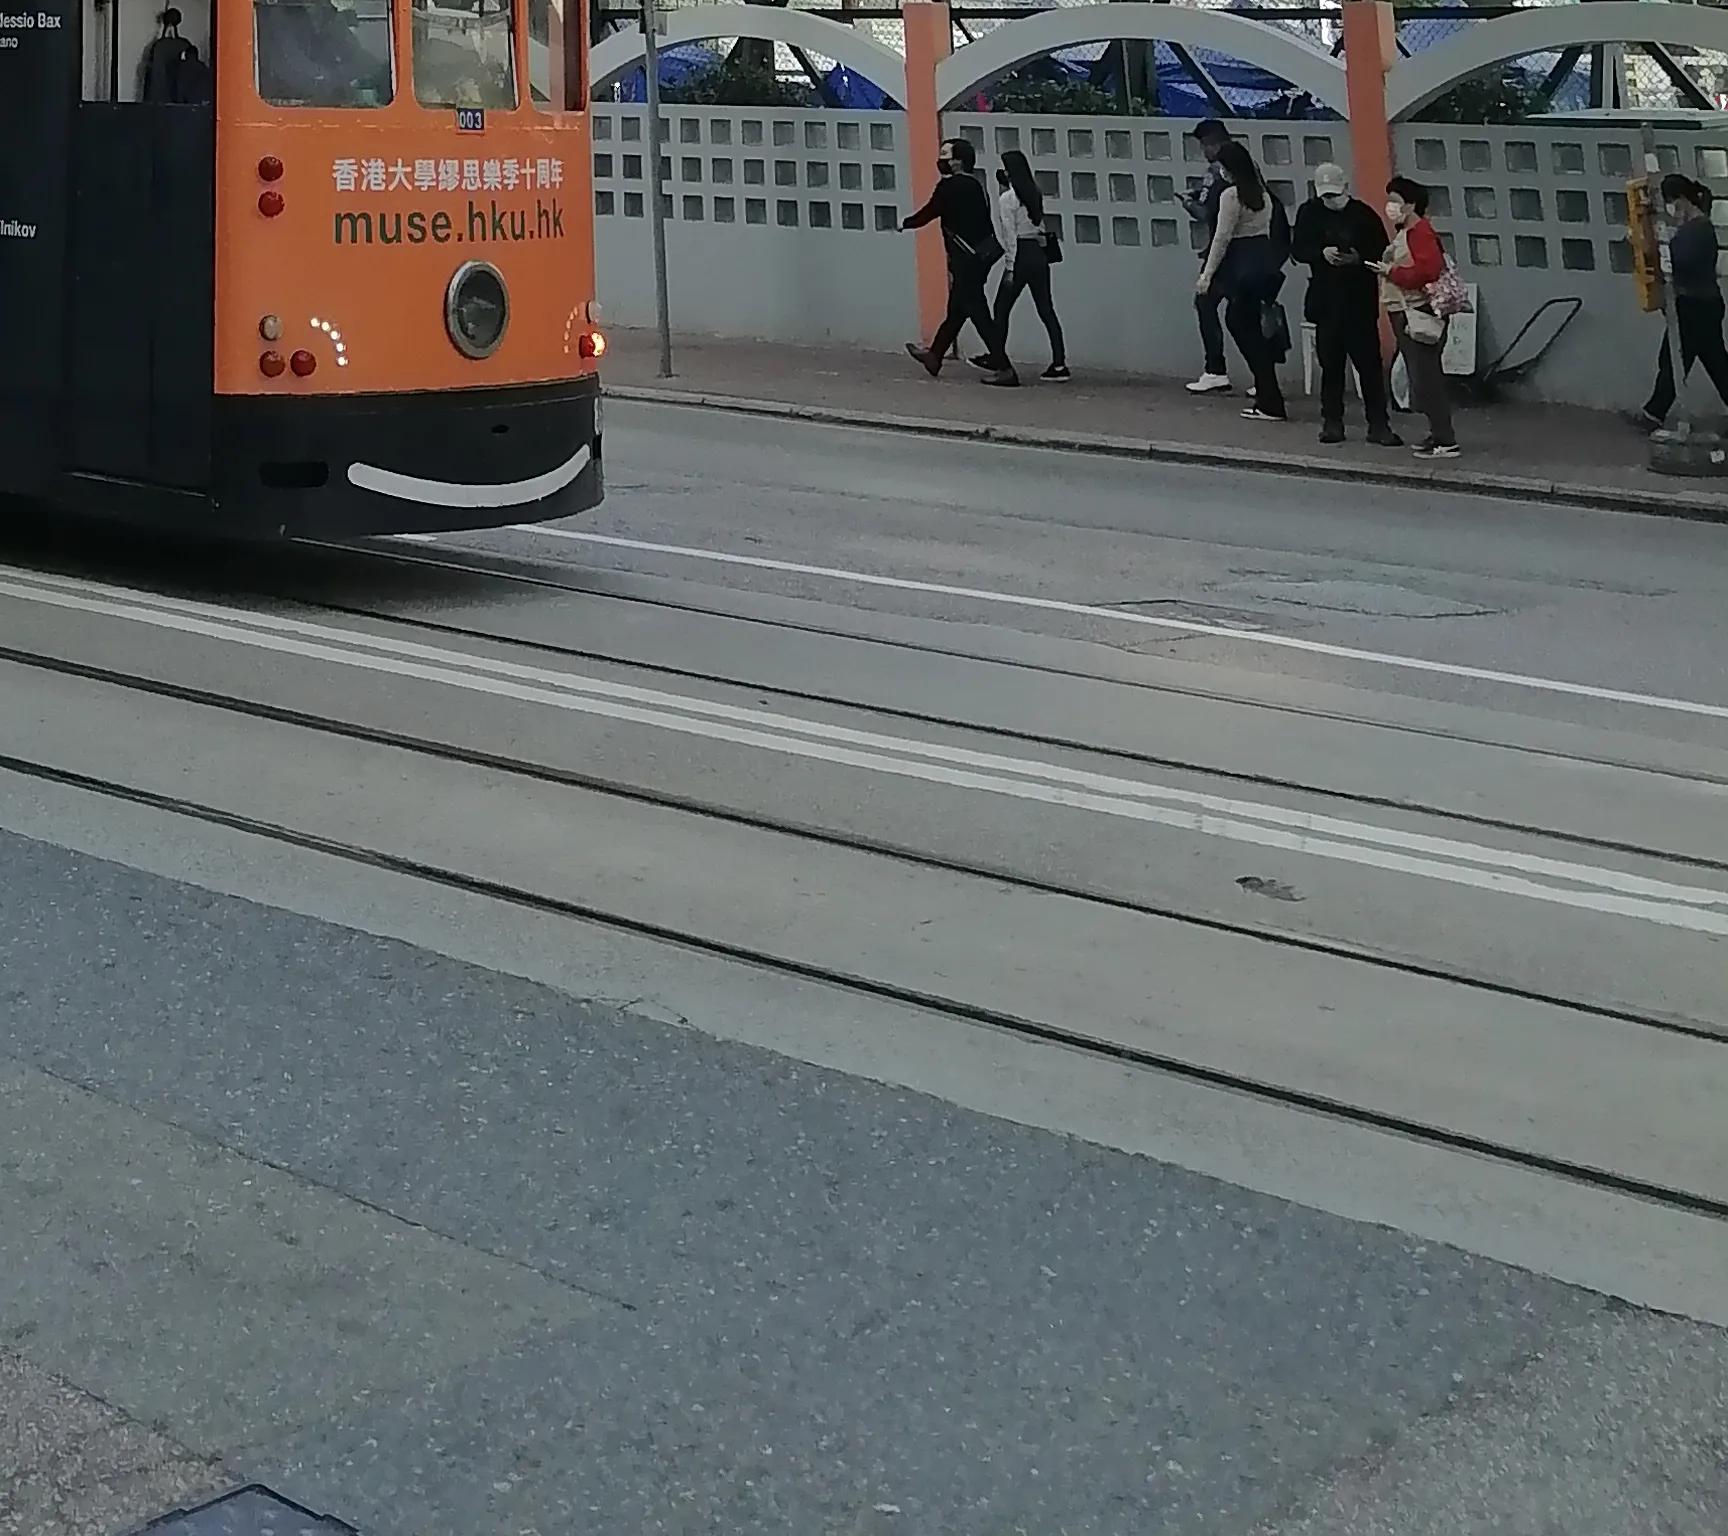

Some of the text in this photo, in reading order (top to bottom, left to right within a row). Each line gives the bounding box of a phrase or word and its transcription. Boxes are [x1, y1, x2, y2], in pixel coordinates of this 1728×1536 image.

[37, 12, 61, 29] Bax
[459, 111, 482, 129] 003
[332, 157, 564, 193] 香港大學繆思樂季十周年
[334, 198, 565, 244] muse.hku.hk
